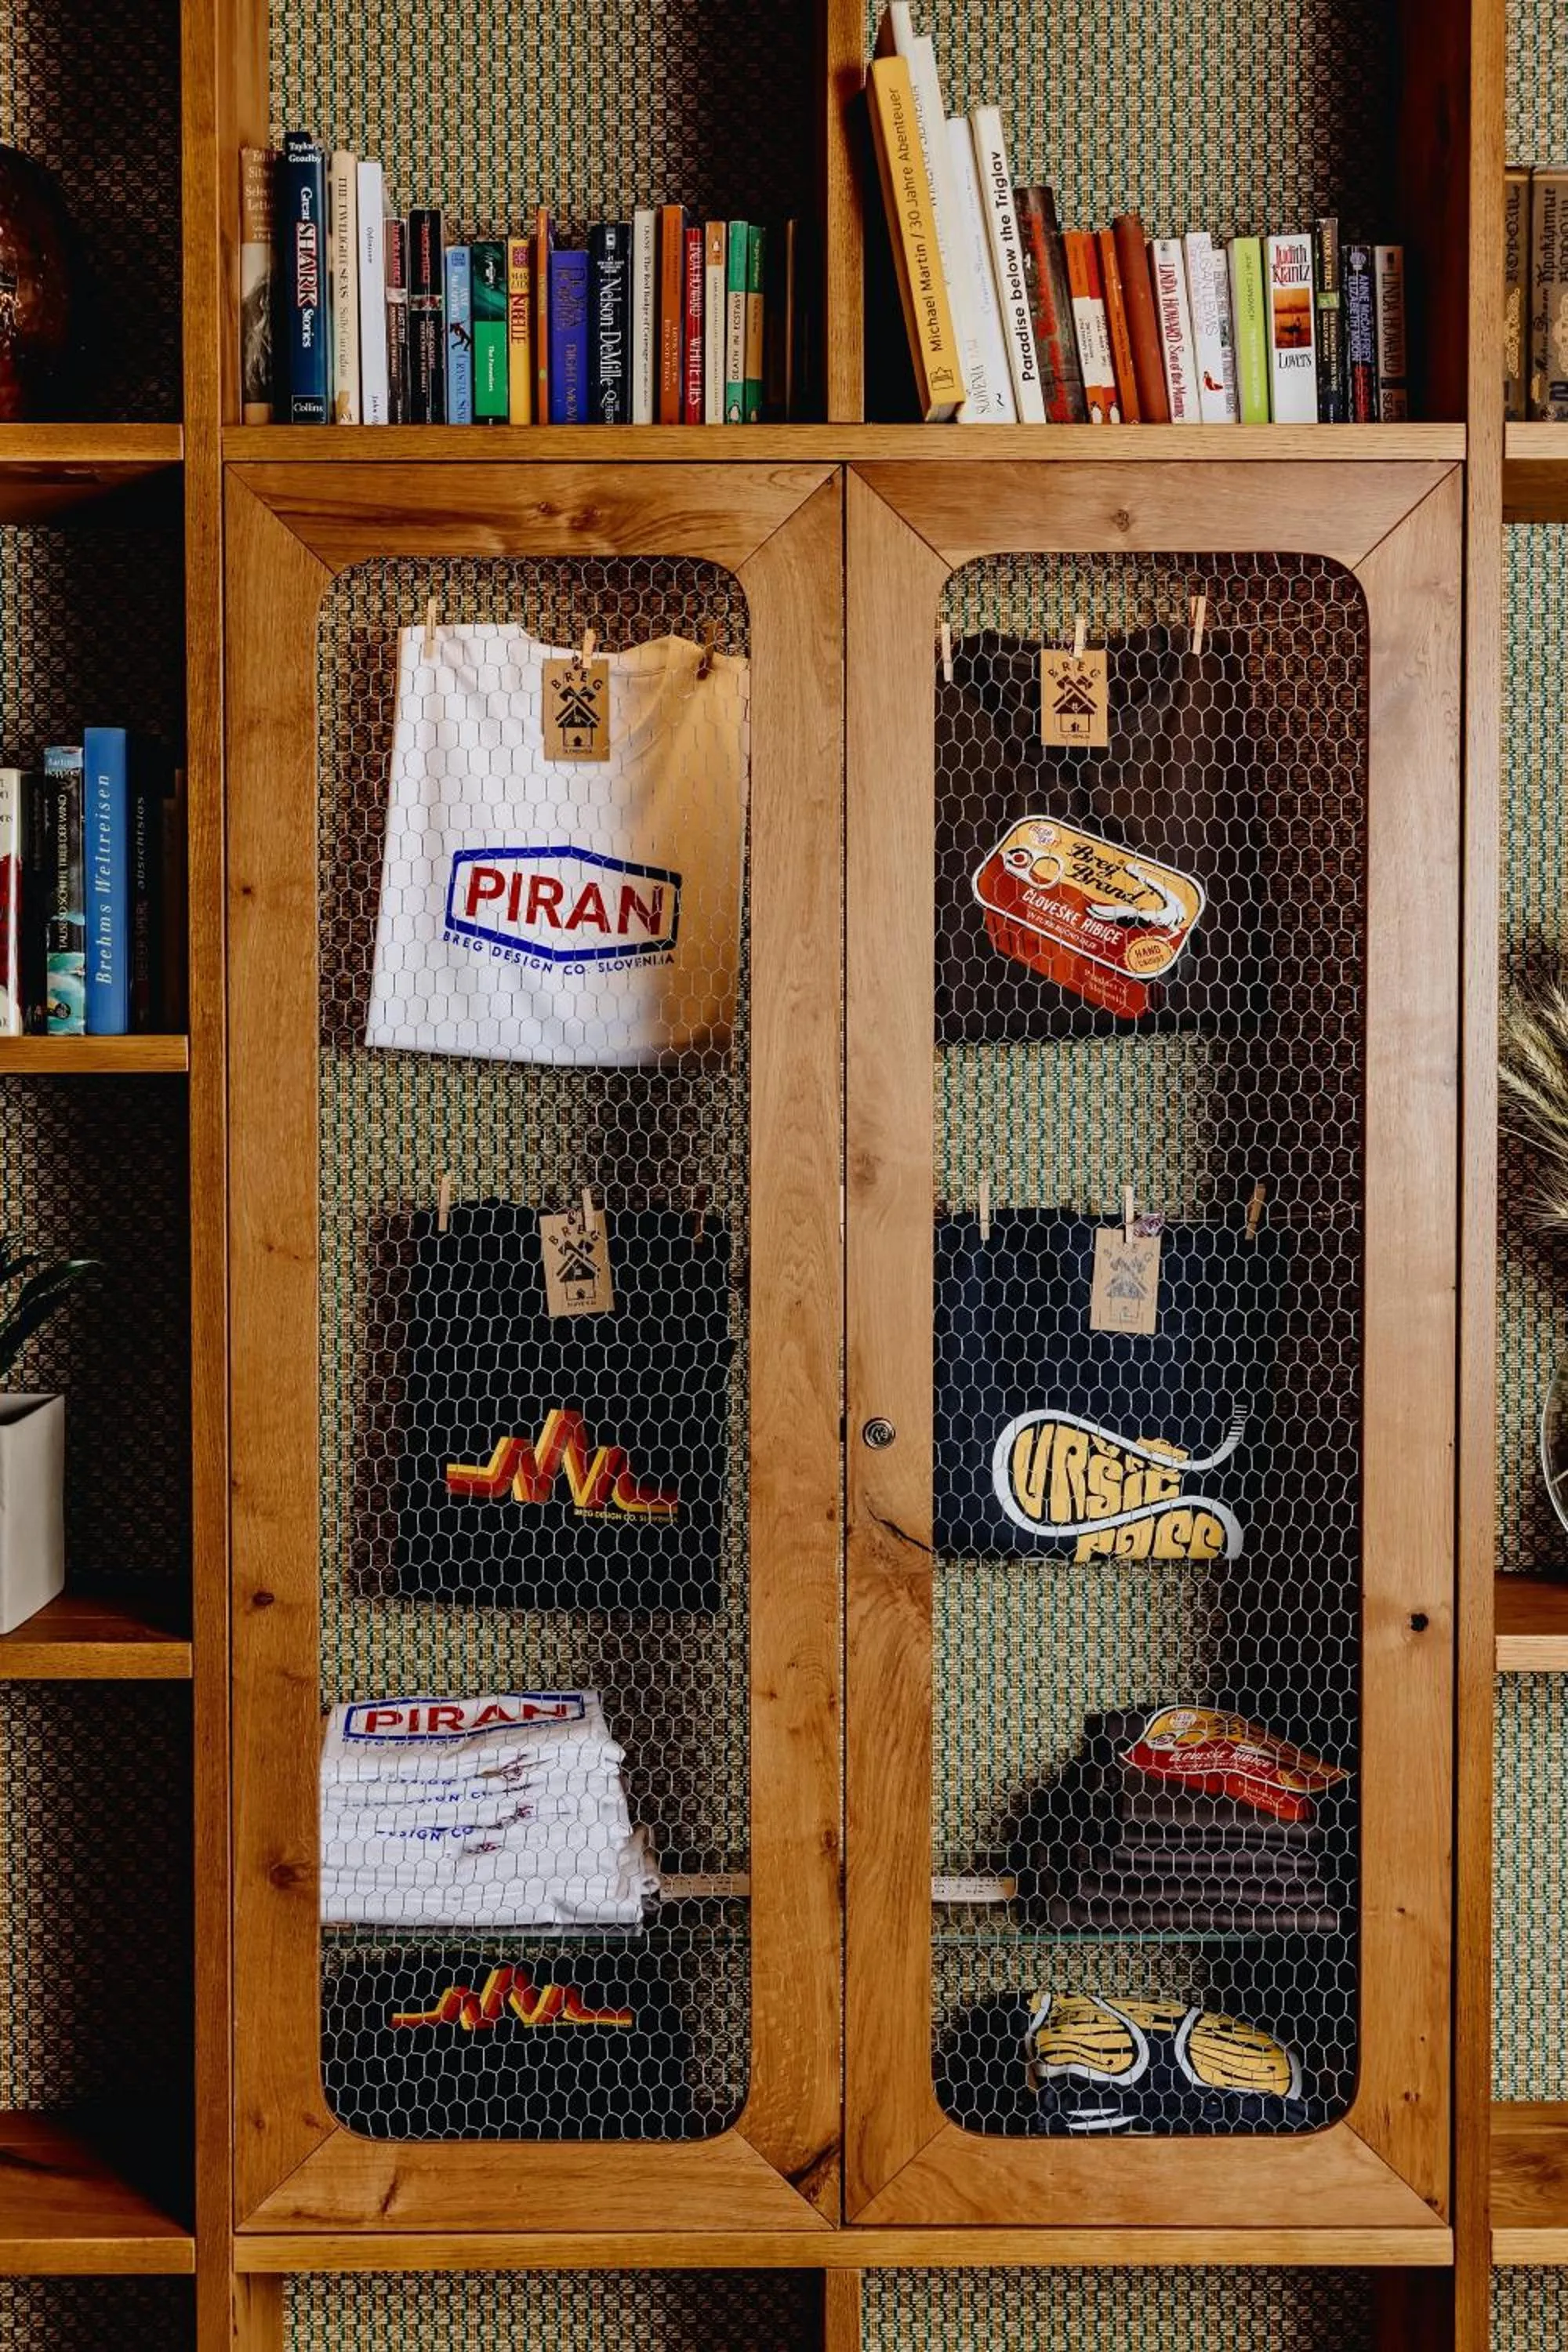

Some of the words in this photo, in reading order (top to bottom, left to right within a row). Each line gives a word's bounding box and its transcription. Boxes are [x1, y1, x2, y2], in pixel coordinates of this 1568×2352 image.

[890, 86, 911, 162] Abenteuer
[338, 176, 348, 198] THE
[904, 166, 918, 207] Jahre
[990, 151, 1009, 210] Triglav
[301, 186, 313, 220] Great
[908, 209, 921, 230] 30
[1000, 214, 1012, 242] the
[296, 223, 318, 308] SHARK
[915, 244, 934, 292] Martin
[1004, 249, 1023, 300] below
[1276, 244, 1308, 264] Judith
[338, 267, 348, 299] SEAS
[1159, 263, 1176, 296] LINDA
[1272, 264, 1311, 286] Krantz
[1358, 274, 1370, 301] ANNE
[1381, 273, 1395, 314] LINDA
[600, 277, 622, 325] Nelson
[1161, 299, 1183, 343] HOWARD
[1348, 275, 1359, 328] ELIZABETH
[302, 309, 314, 348] Stories
[924, 299, 943, 354] Michael
[1013, 307, 1035, 382] Paradise
[1359, 303, 1371, 362] McCAFFREY
[1381, 318, 1397, 375] HOWARD
[600, 328, 622, 387] DeMille
[689, 336, 702, 379] WHITE
[1279, 352, 1312, 369] Lovers
[293, 403, 324, 413] Collins
[689, 381, 702, 405] LIES
[550, 670, 603, 690] BREG
[1047, 661, 1102, 678] BREG
[58, 793, 67, 822] WIND
[95, 774, 112, 896] Weltreisen
[1066, 841, 1122, 880] Breg
[464, 866, 664, 935] PIRAN
[1065, 862, 1146, 905] Brand
[1022, 887, 1083, 925] ČLOVEŠKE
[1080, 917, 1123, 946] RIBICE
[95, 904, 112, 985] Brehms
[442, 930, 484, 952] BREG
[491, 946, 554, 974] DESIGN
[547, 1224, 601, 1246] BREG
[365, 1703, 568, 1733] PIRAN
